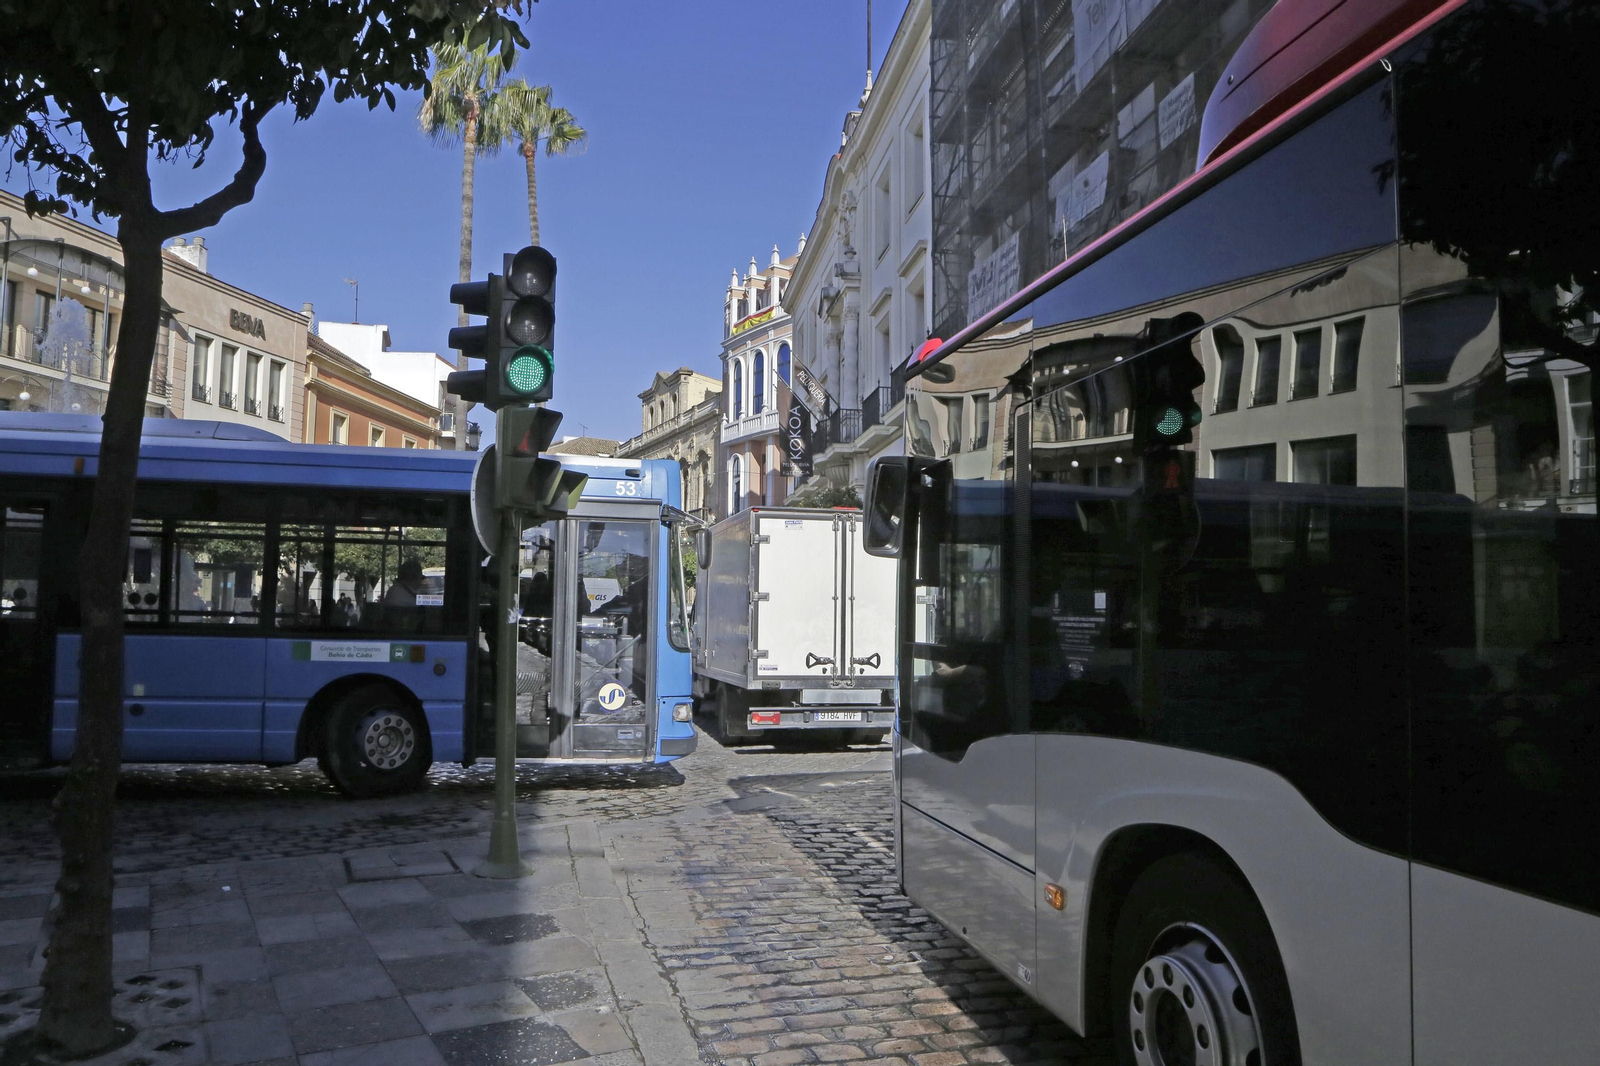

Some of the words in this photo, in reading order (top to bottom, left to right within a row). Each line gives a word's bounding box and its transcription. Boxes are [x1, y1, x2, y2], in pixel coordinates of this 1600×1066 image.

[230, 308, 267, 342] BBVA
[796, 370, 827, 406] PELUQUERIA
[615, 480, 636, 496] 53
[820, 711, 840, 719] 9184
[843, 711, 858, 719] HVF
